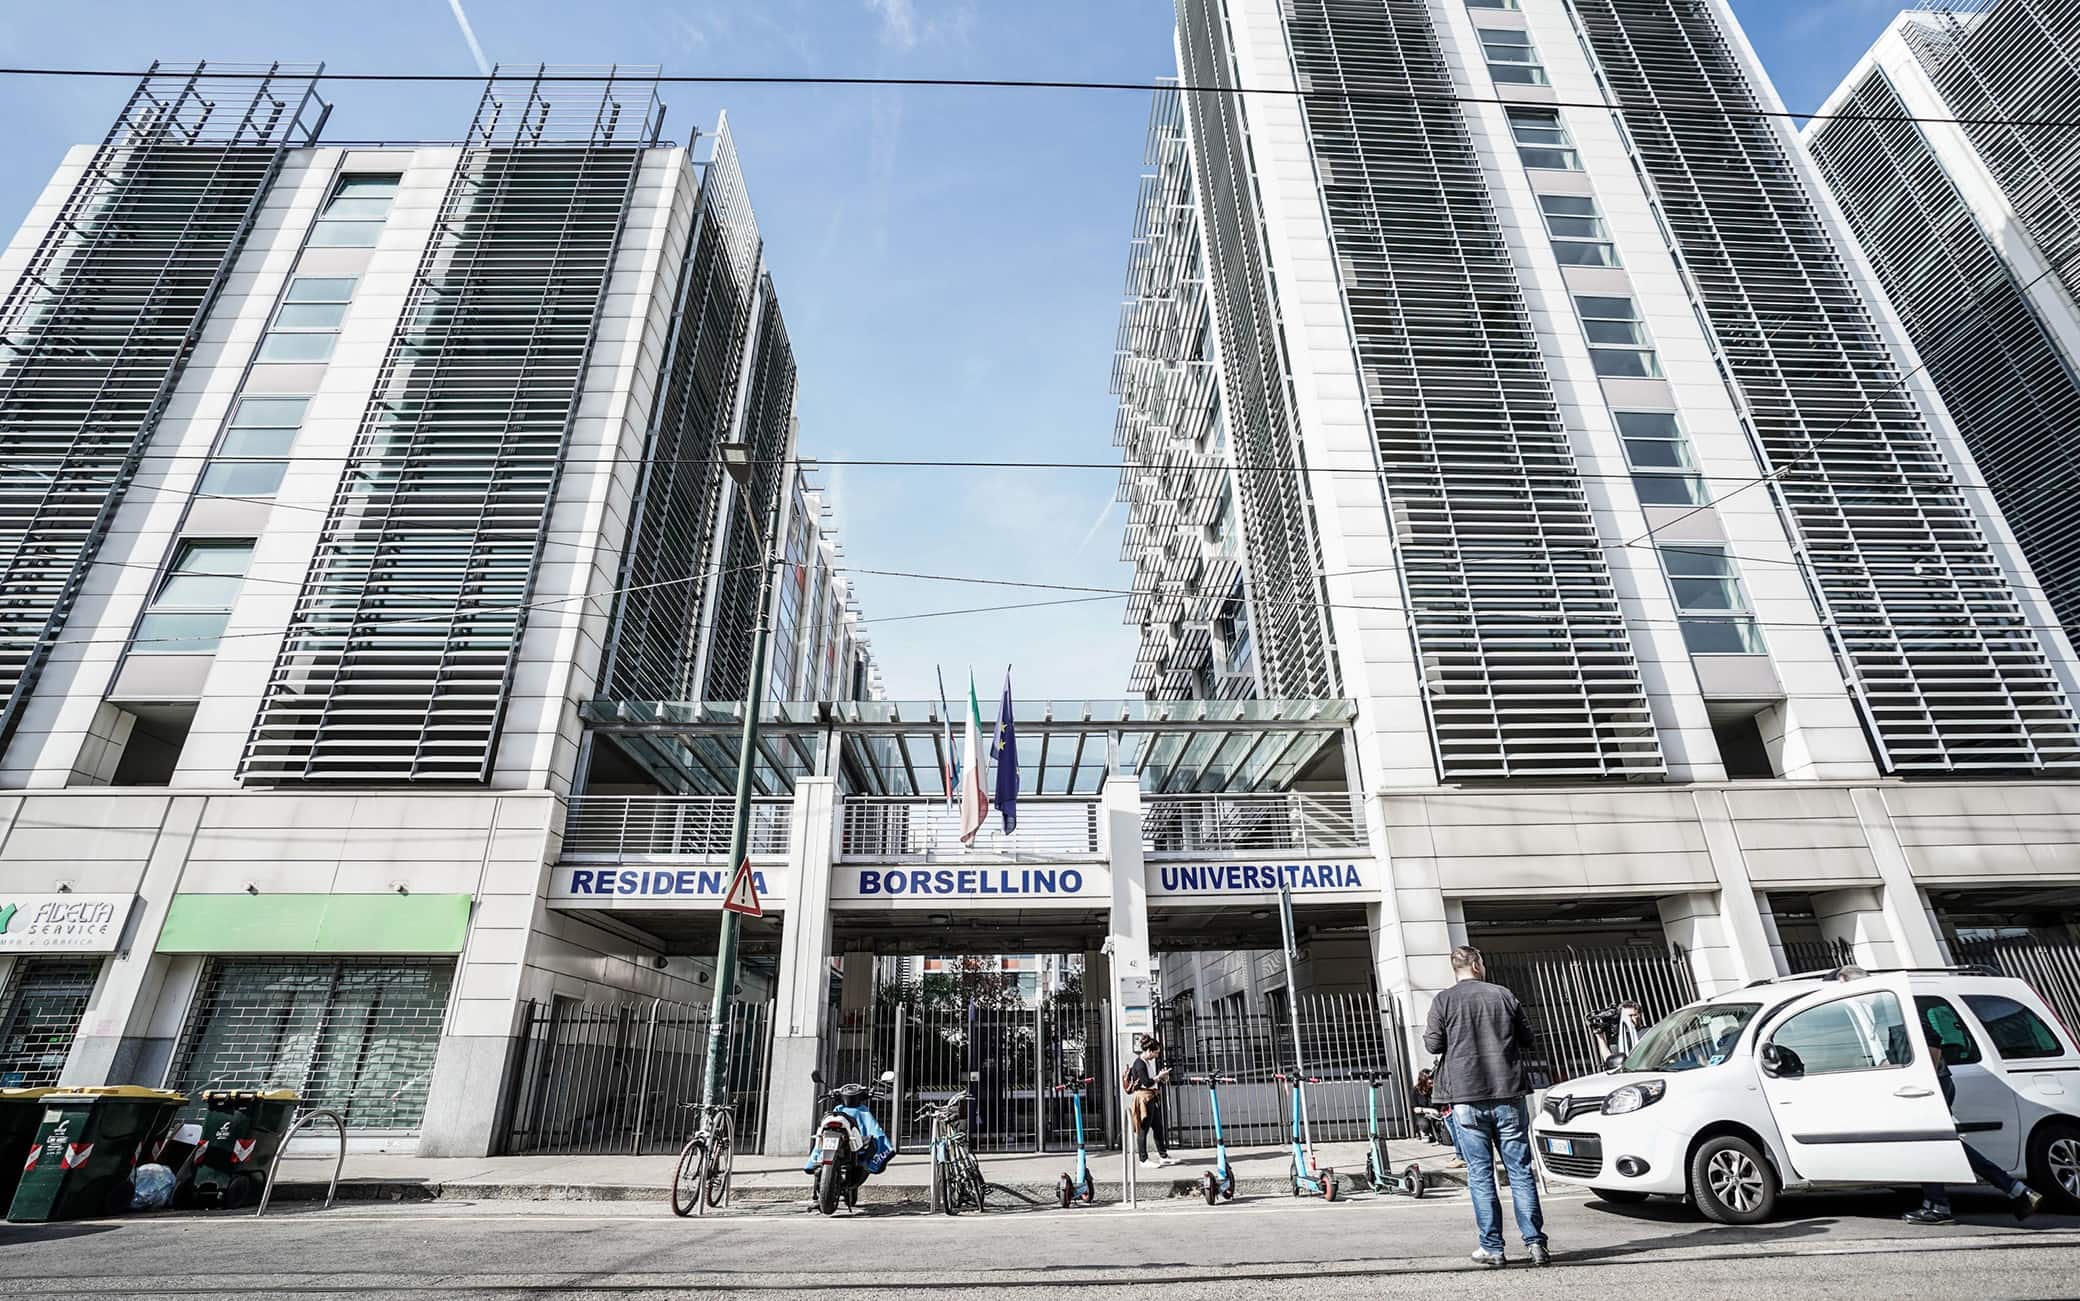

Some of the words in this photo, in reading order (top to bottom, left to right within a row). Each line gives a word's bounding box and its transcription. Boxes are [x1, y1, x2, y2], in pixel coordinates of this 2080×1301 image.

[570, 870, 769, 895] RESIDENA
[859, 869, 1083, 894] BORSELLINO
[1161, 864, 1362, 891] UNIVERSITARIA
[28, 924, 108, 935] SERVICE
